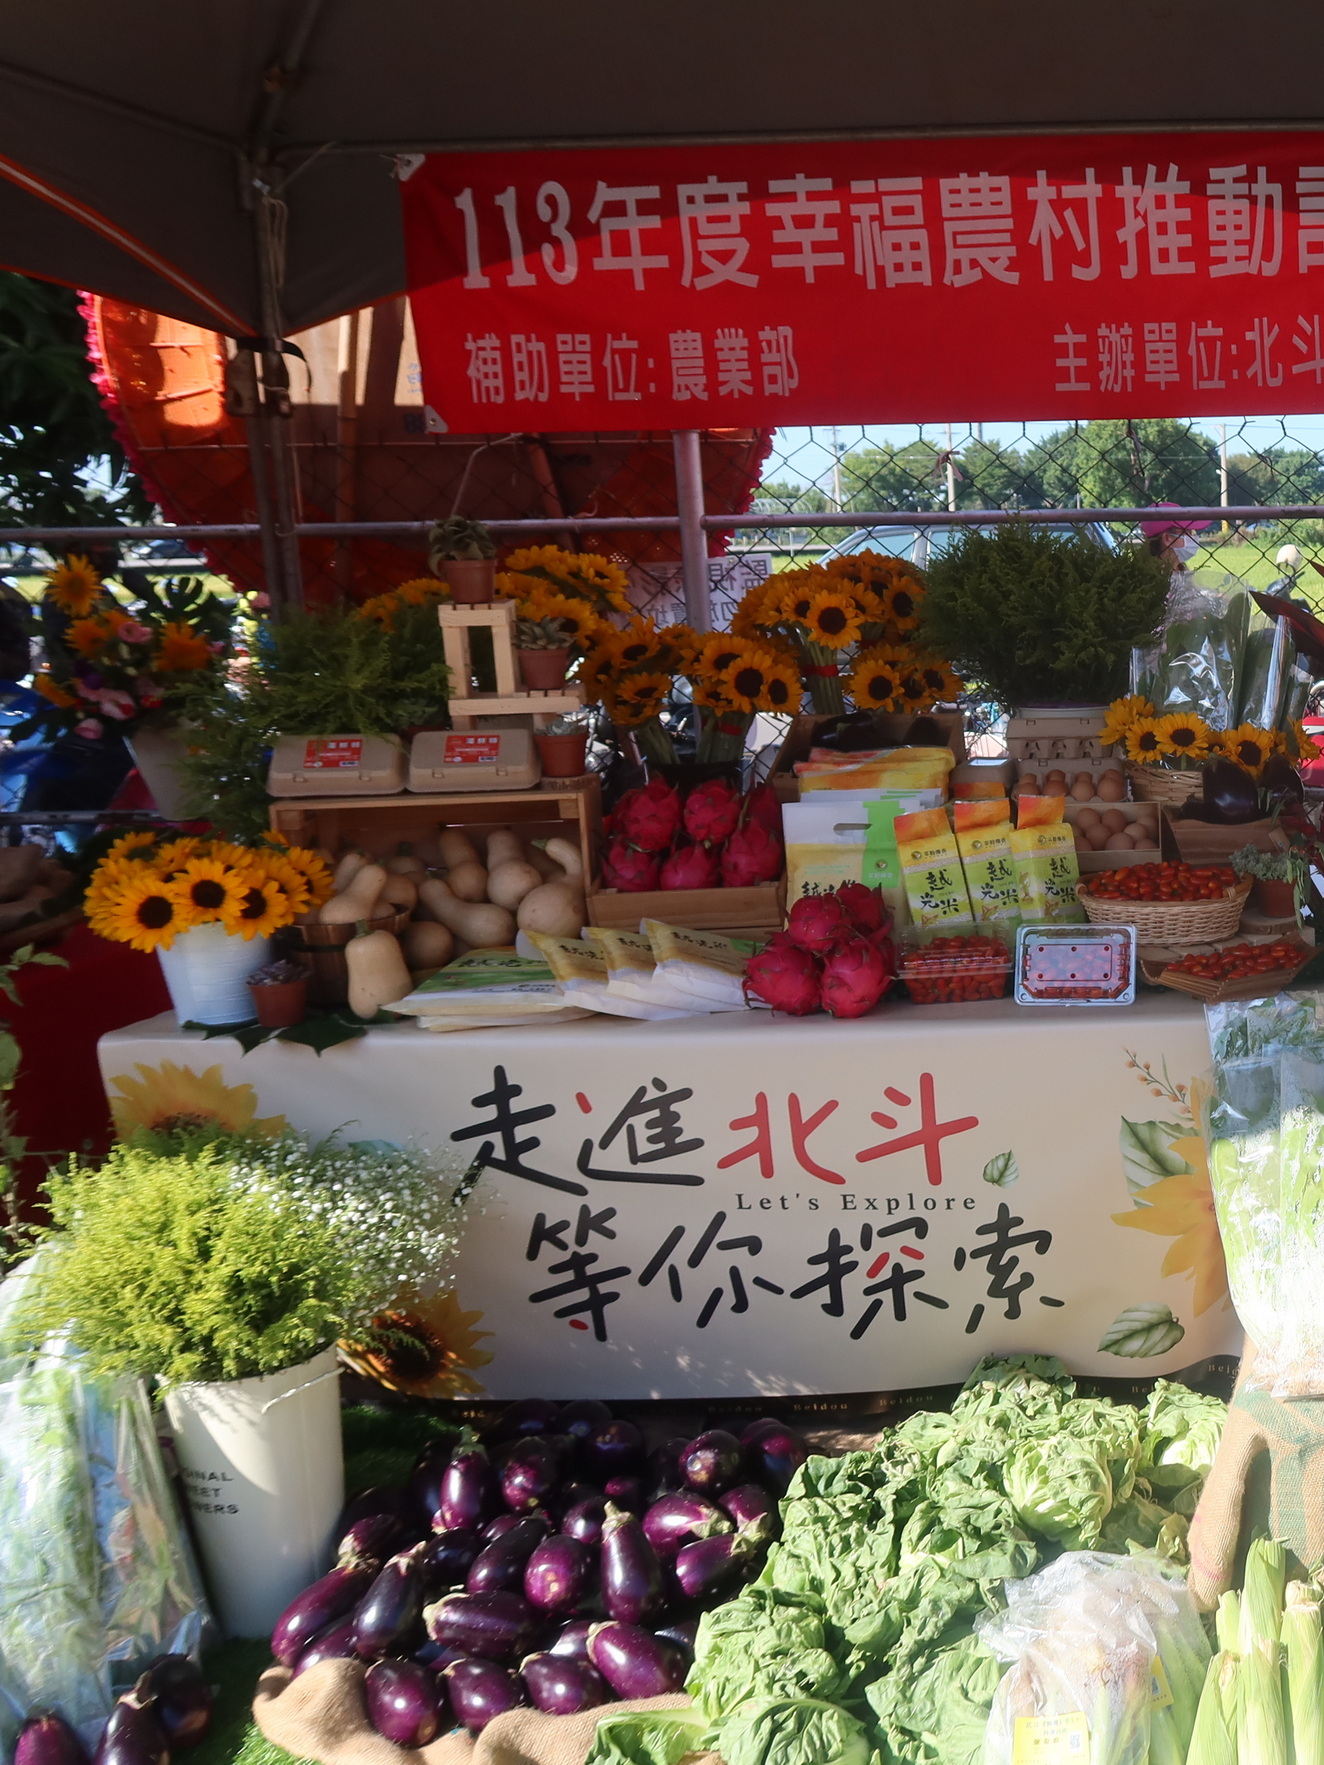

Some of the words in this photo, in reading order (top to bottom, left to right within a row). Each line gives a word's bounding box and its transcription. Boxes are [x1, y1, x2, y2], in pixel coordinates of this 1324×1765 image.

[464, 325, 799, 404] 補助單位:農業部
[451, 1064, 980, 1204] 走進北斗
[735, 1193, 820, 1211] Let's
[841, 1192, 977, 1216] Explore
[526, 1202, 1066, 1343] 等你探索
[793, 1402, 848, 1412] Beidou
[879, 1395, 933, 1407] Beidou
